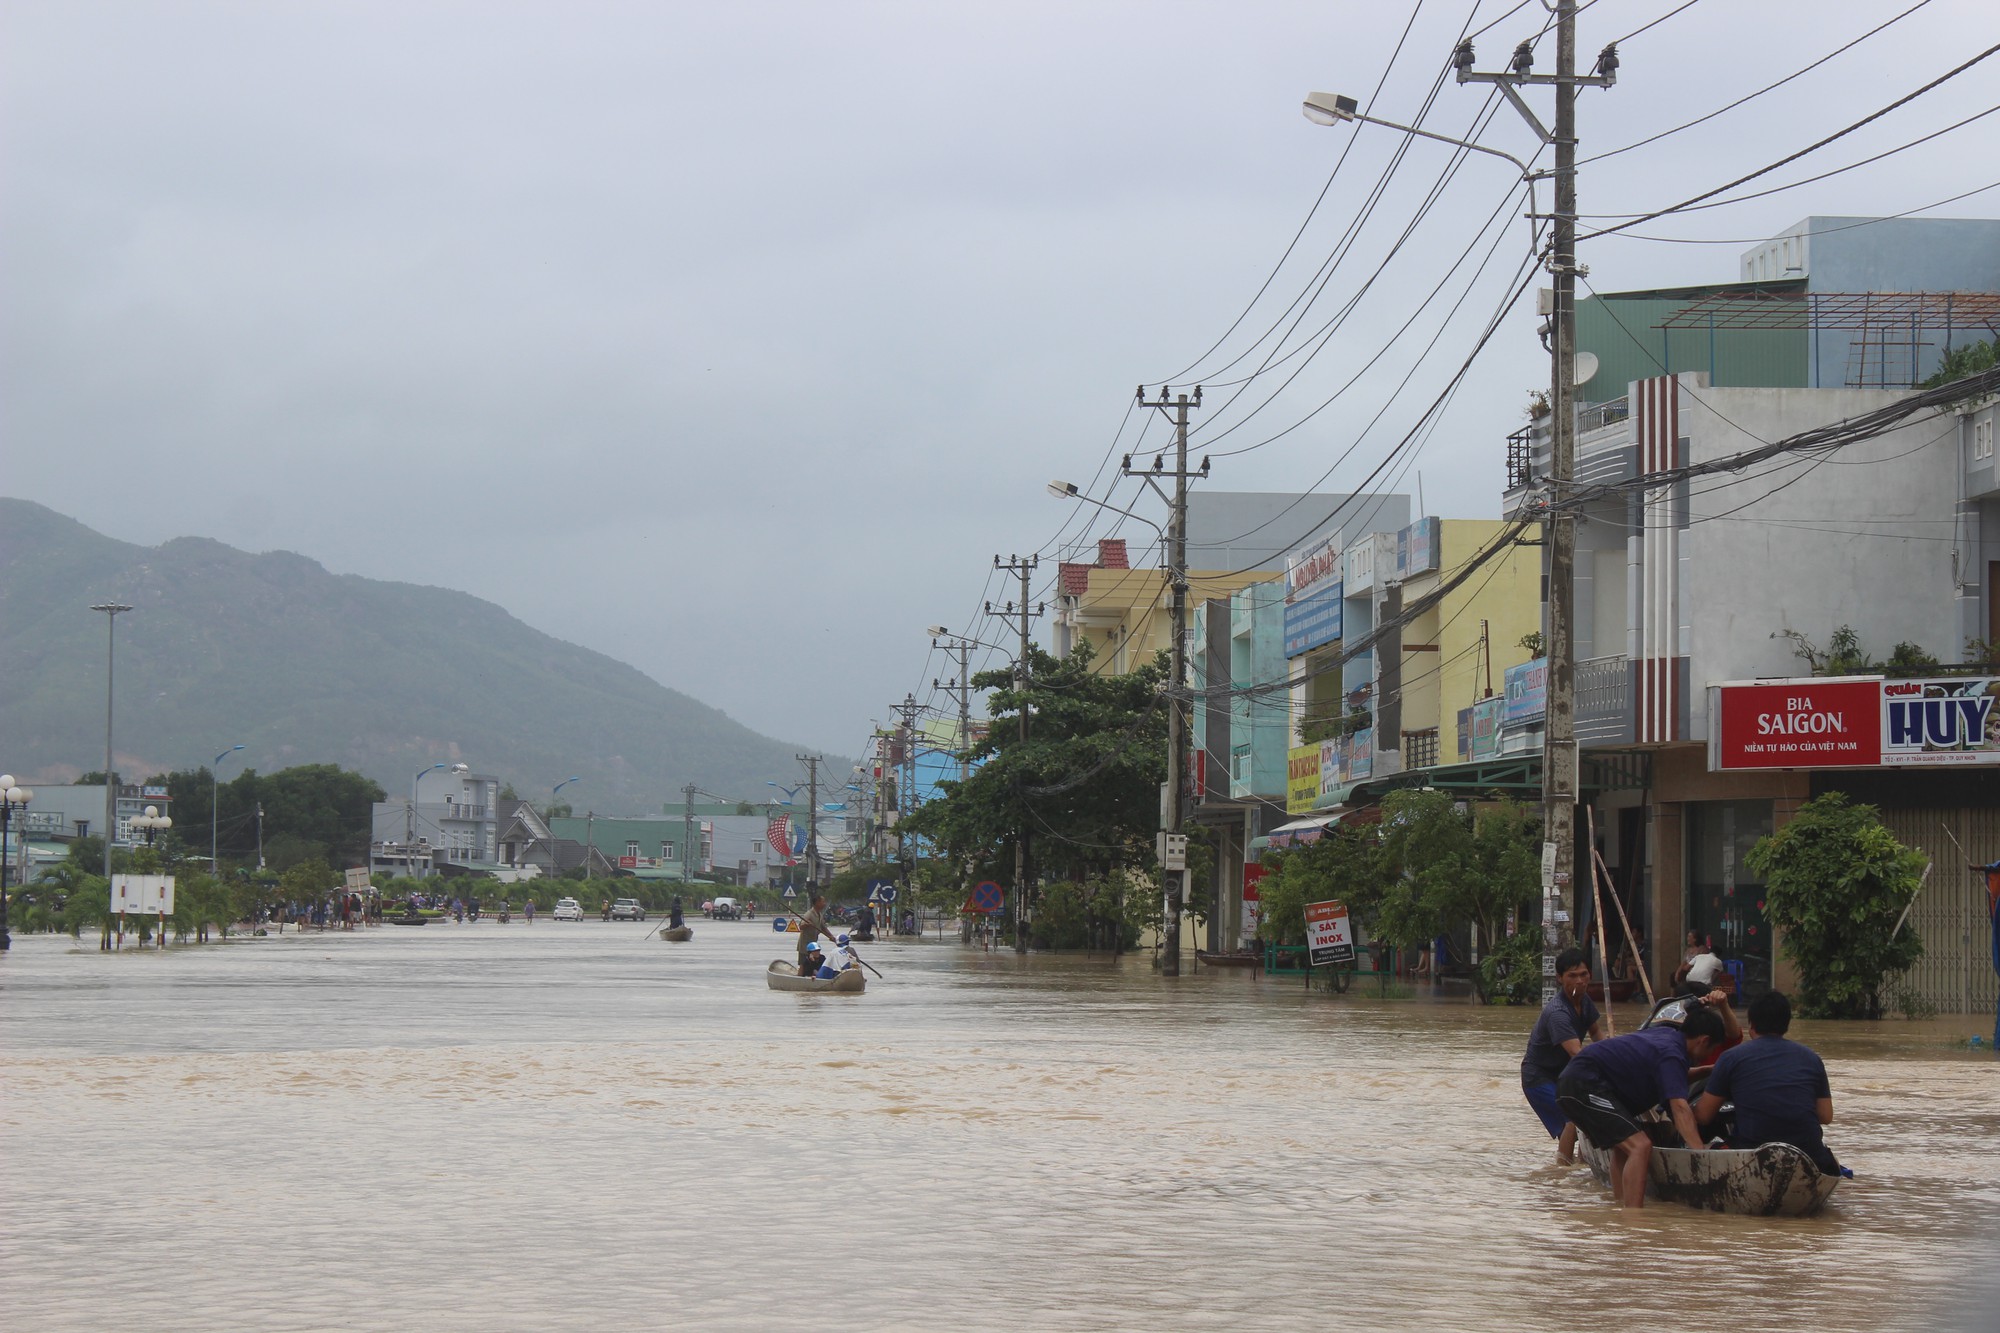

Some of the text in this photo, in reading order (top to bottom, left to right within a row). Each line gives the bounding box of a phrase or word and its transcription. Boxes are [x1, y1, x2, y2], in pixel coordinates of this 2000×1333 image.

[1787, 697, 1813, 711] BIA
[1758, 711, 1843, 735] SAIGON
[1888, 697, 1994, 747] HUY
[1837, 741, 1857, 751] NAM
[1316, 934, 1343, 945] INOX
